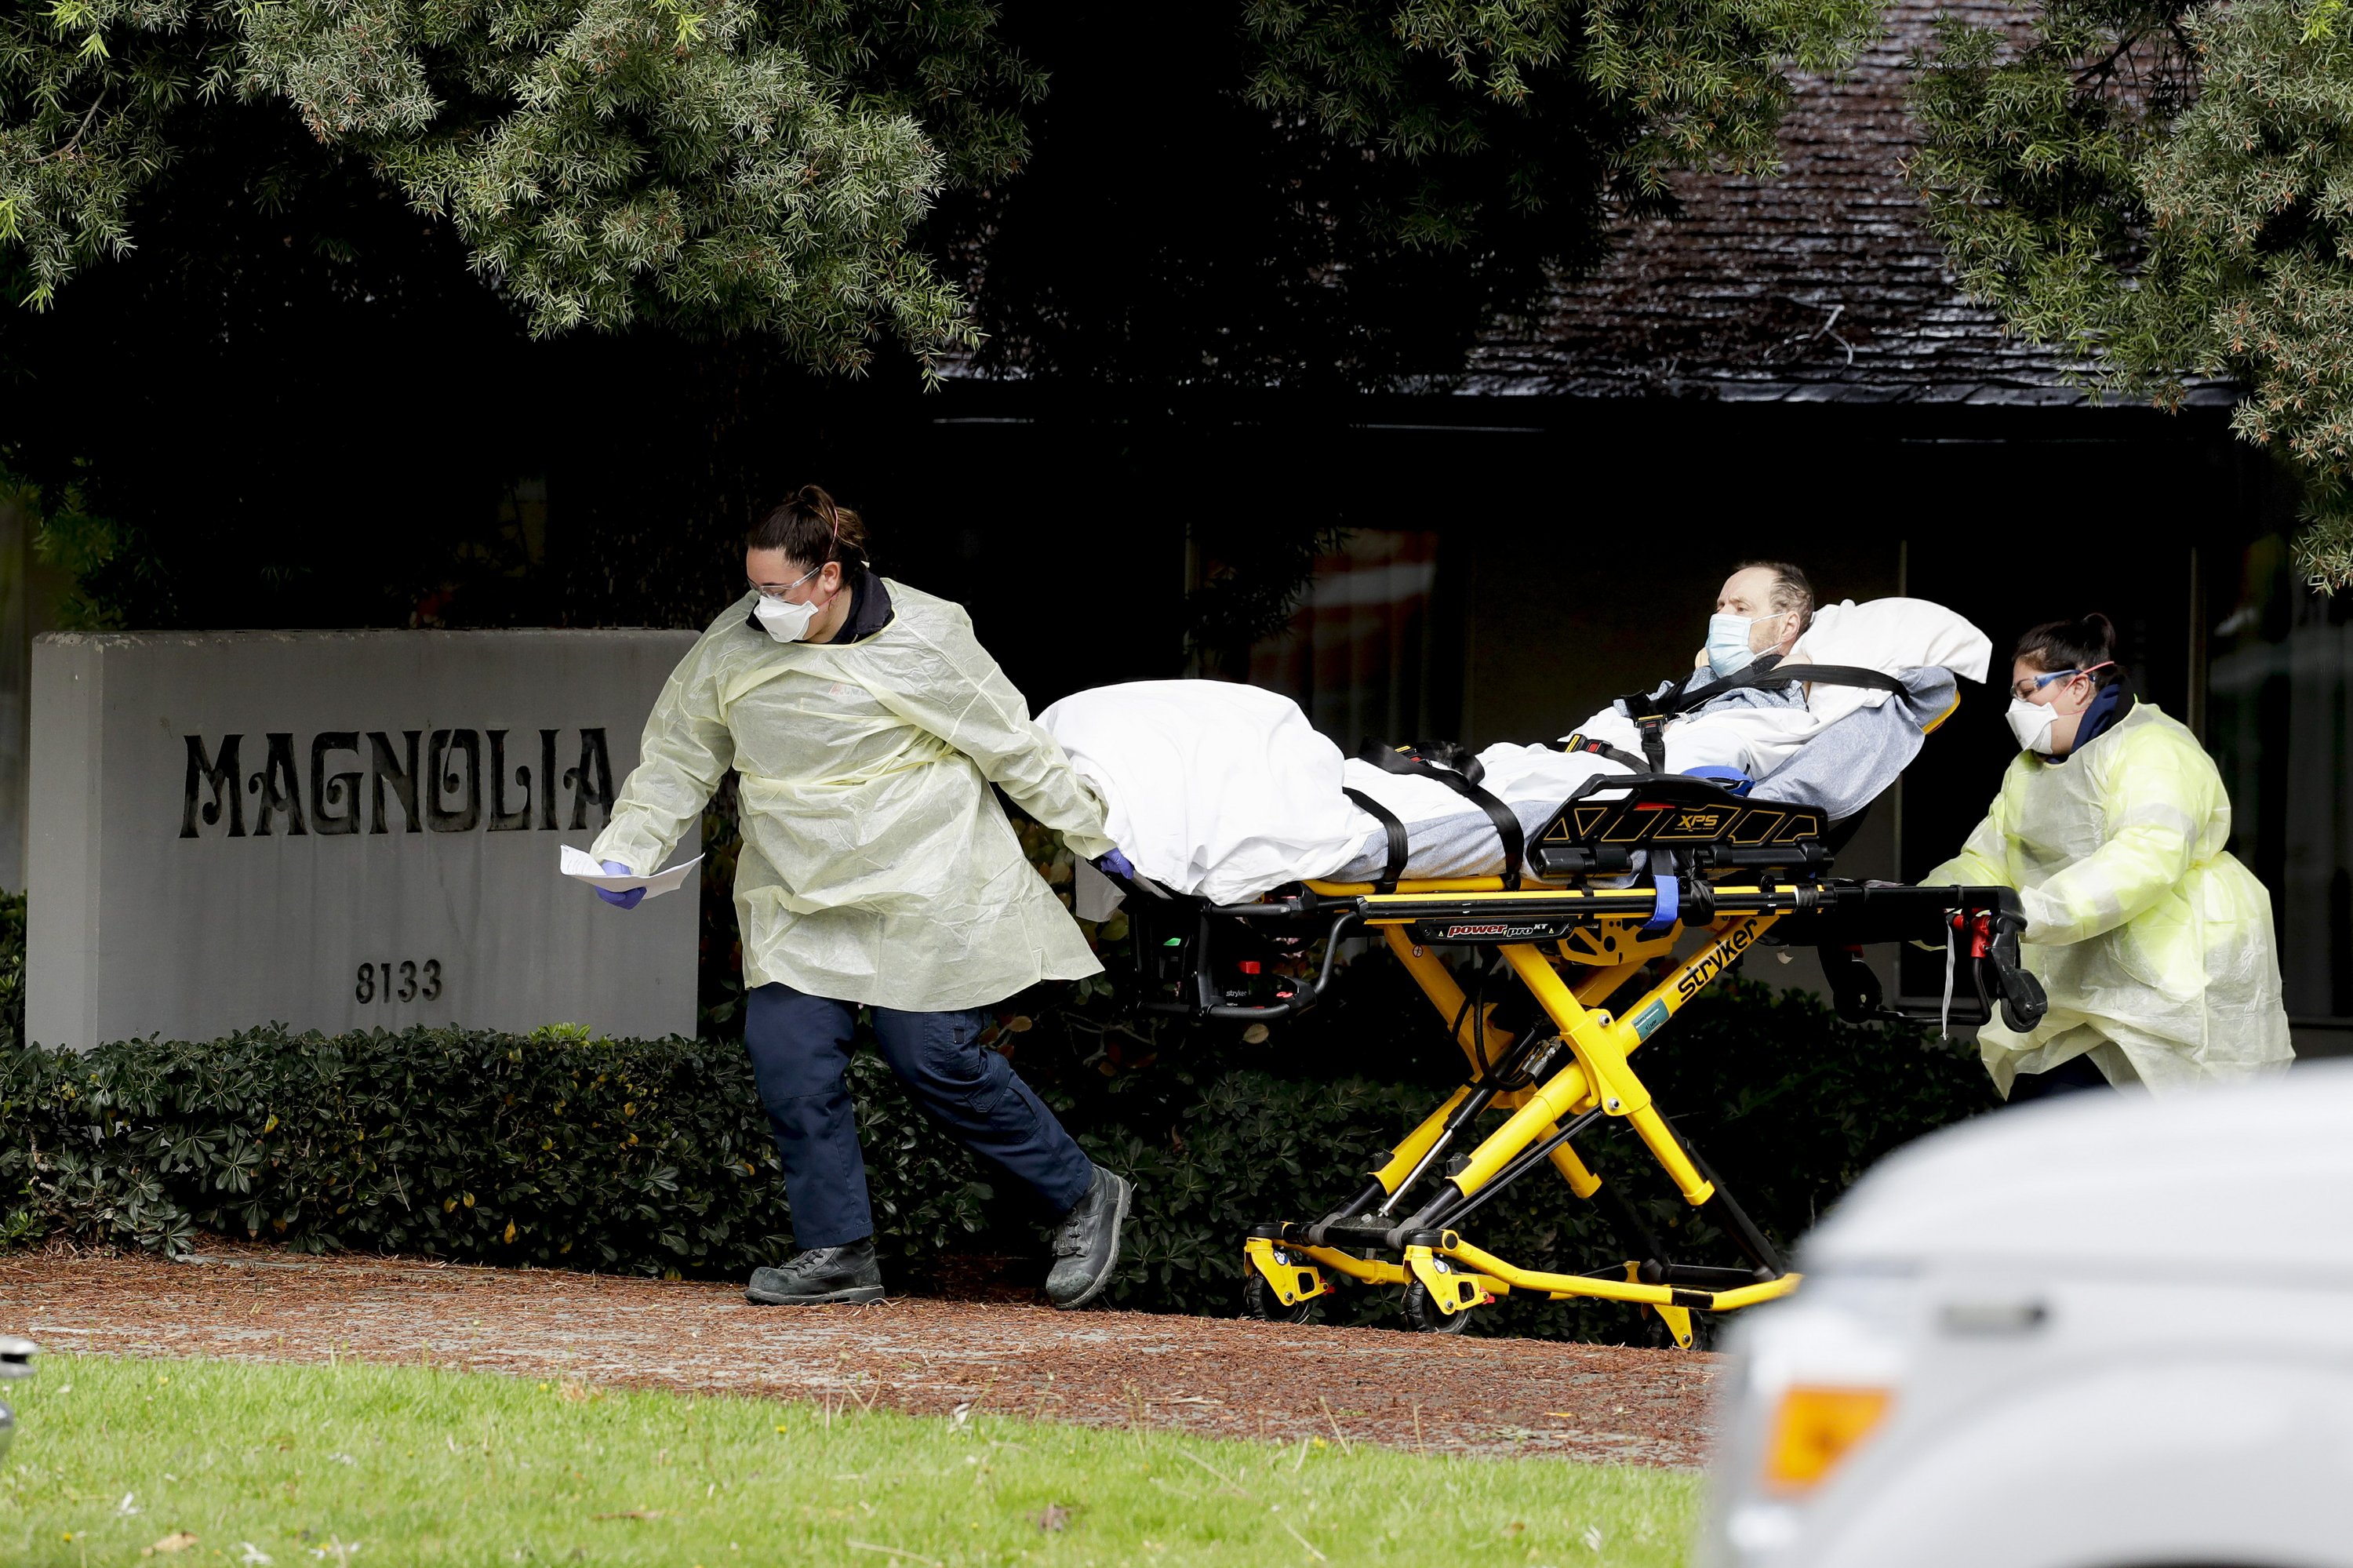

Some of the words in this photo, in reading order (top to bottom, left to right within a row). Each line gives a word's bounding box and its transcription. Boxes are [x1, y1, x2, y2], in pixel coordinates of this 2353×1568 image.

[179, 728, 614, 839] MAGNOLIA
[1677, 815, 1719, 828] XPS
[355, 959, 442, 1004] 8133
[1677, 919, 1758, 1002] stryker
